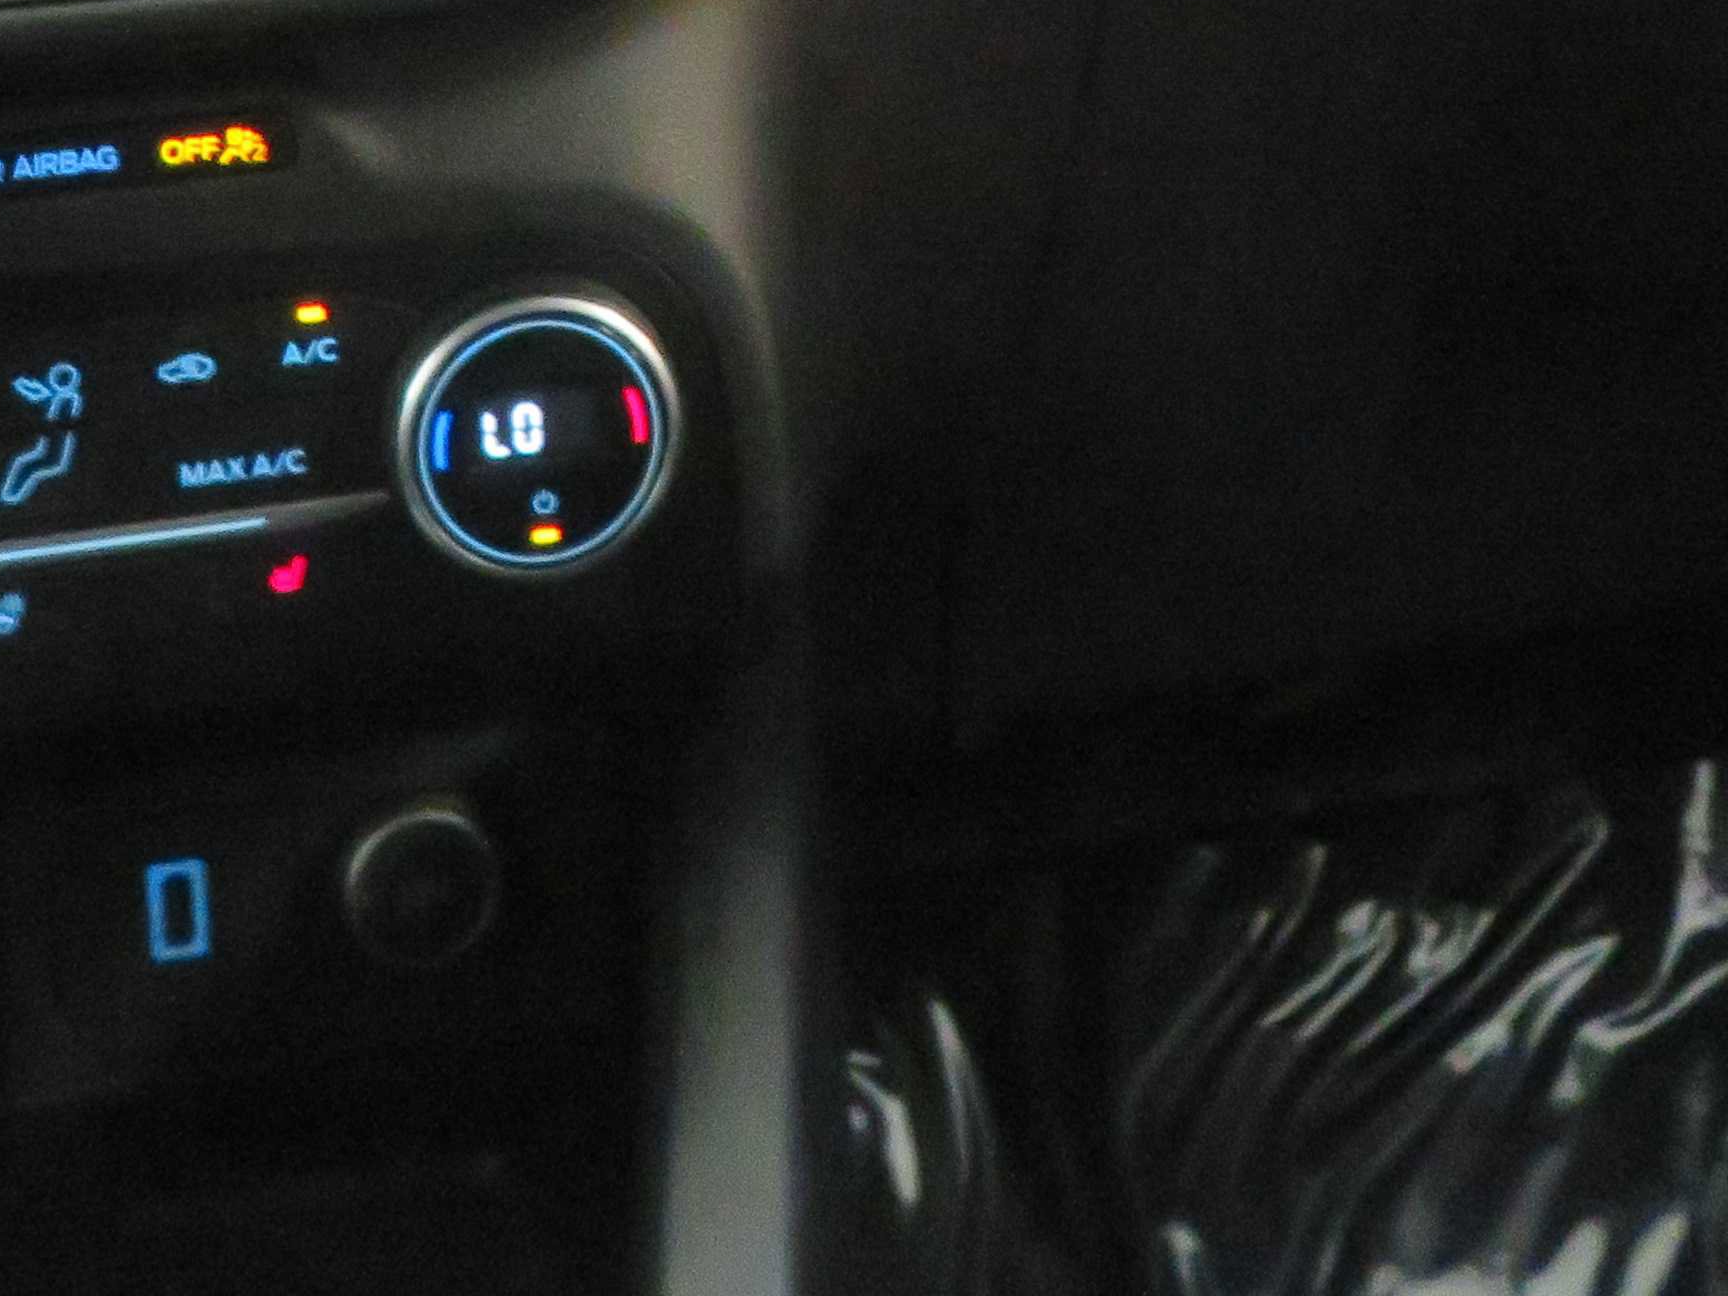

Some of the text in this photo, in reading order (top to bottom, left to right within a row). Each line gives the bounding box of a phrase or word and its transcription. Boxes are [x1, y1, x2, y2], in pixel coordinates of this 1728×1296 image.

[12, 145, 119, 180] AIRBAG
[160, 135, 222, 165] OFF
[281, 337, 340, 366] A/C
[179, 448, 309, 489] MAX A/C
